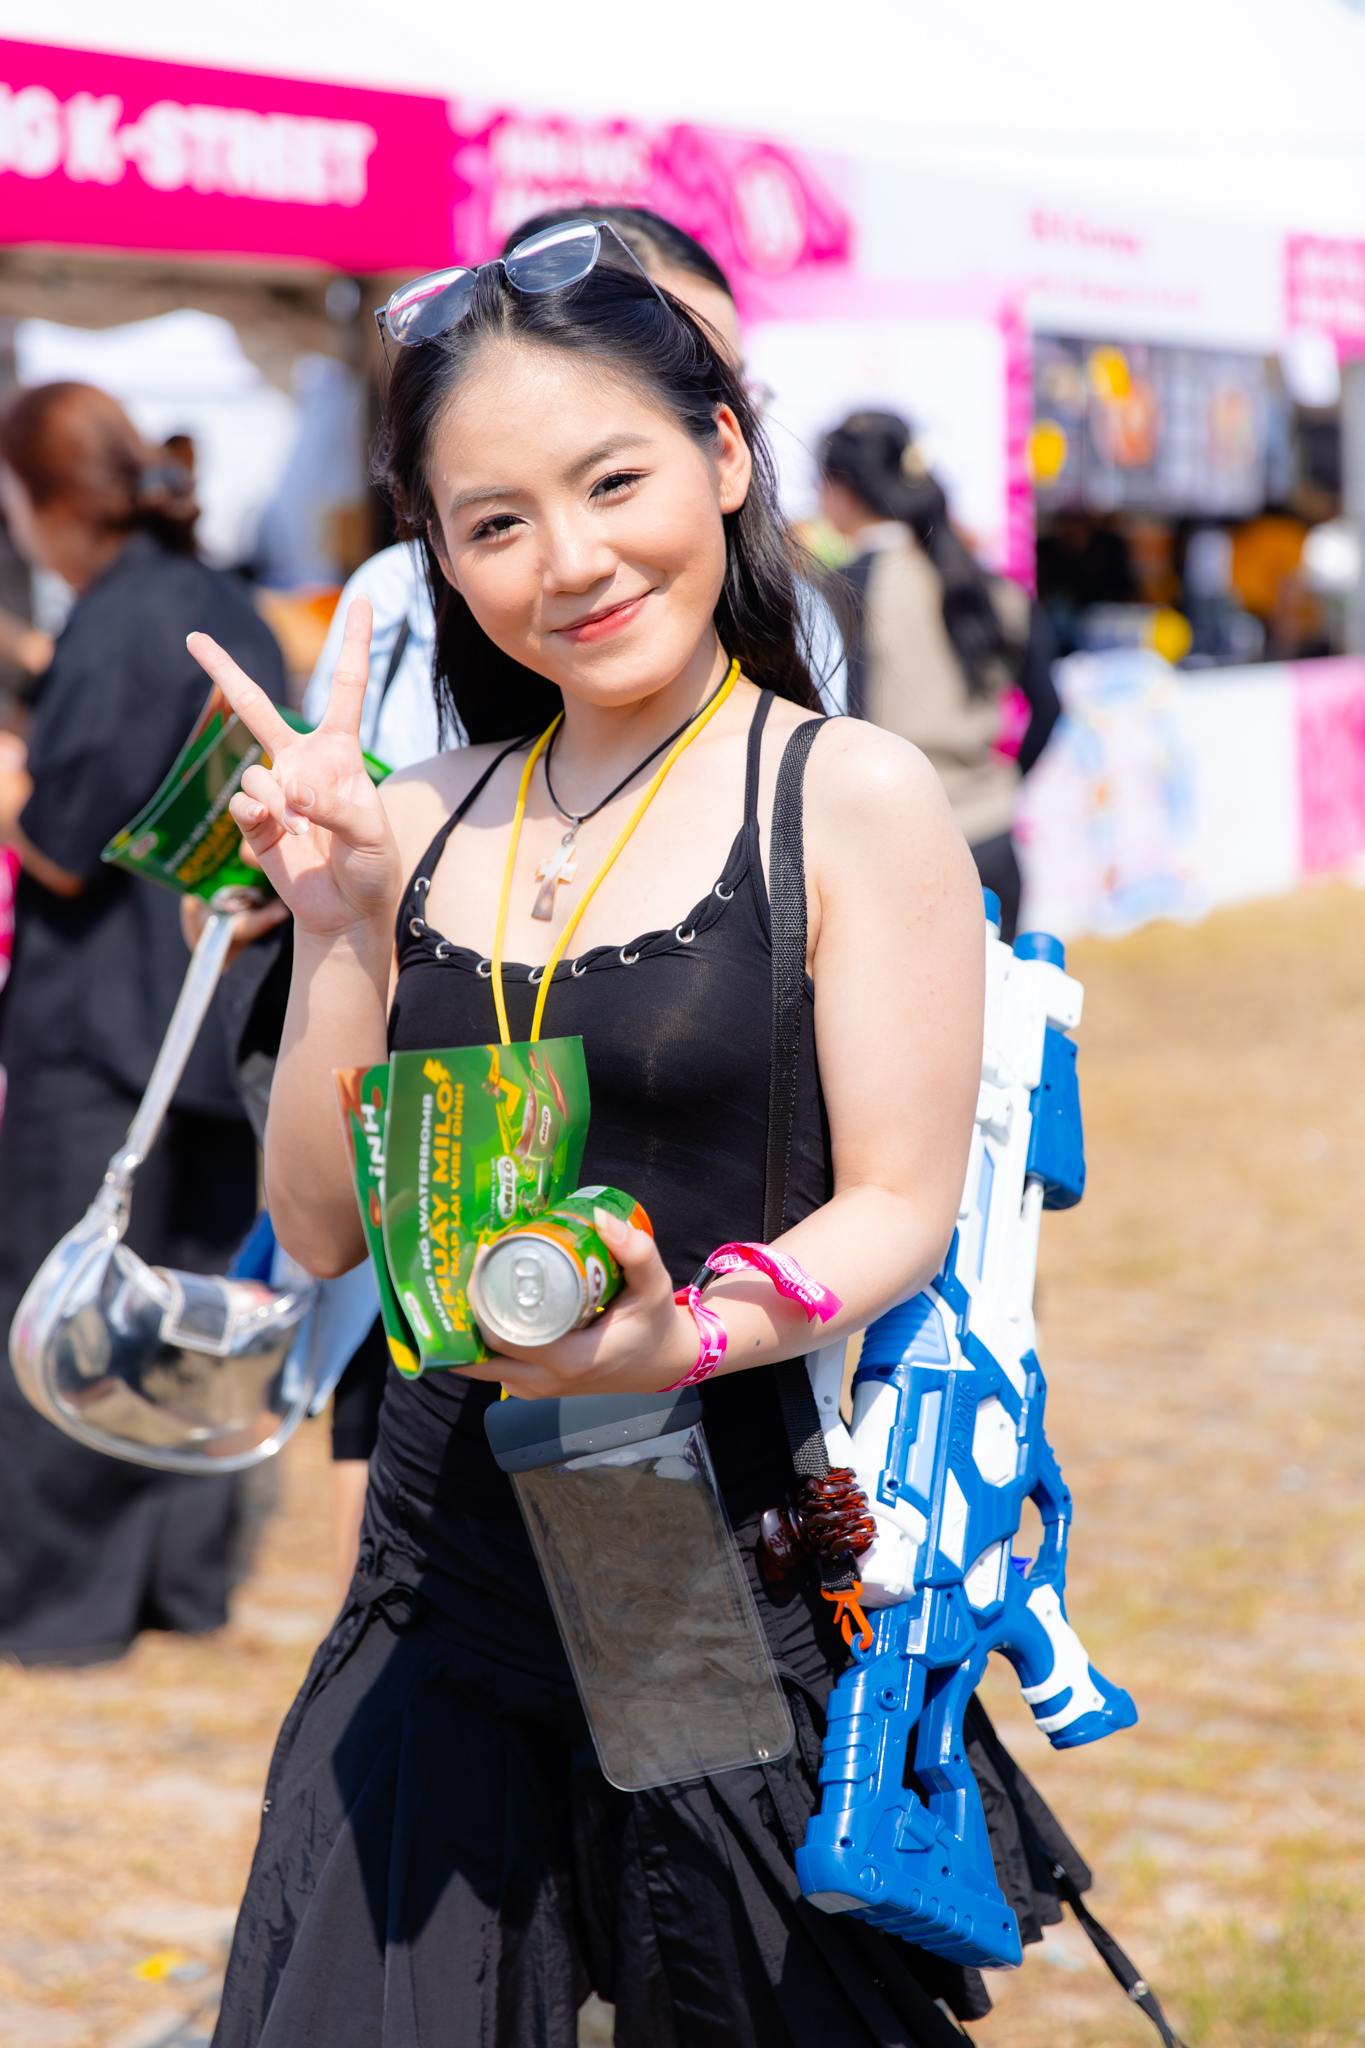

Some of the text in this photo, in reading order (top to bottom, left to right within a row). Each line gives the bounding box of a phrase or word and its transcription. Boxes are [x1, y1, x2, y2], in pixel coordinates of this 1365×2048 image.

[65, 92, 378, 207] K-STREET
[418, 1093, 433, 1232] WATERBOMB
[432, 1081, 454, 1183] MILO
[451, 1141, 462, 1190] VIBE
[503, 1160, 513, 1215] MILO
[520, 1413, 677, 1461] WATERPROOF
[951, 1382, 976, 1473] JIA YANG
